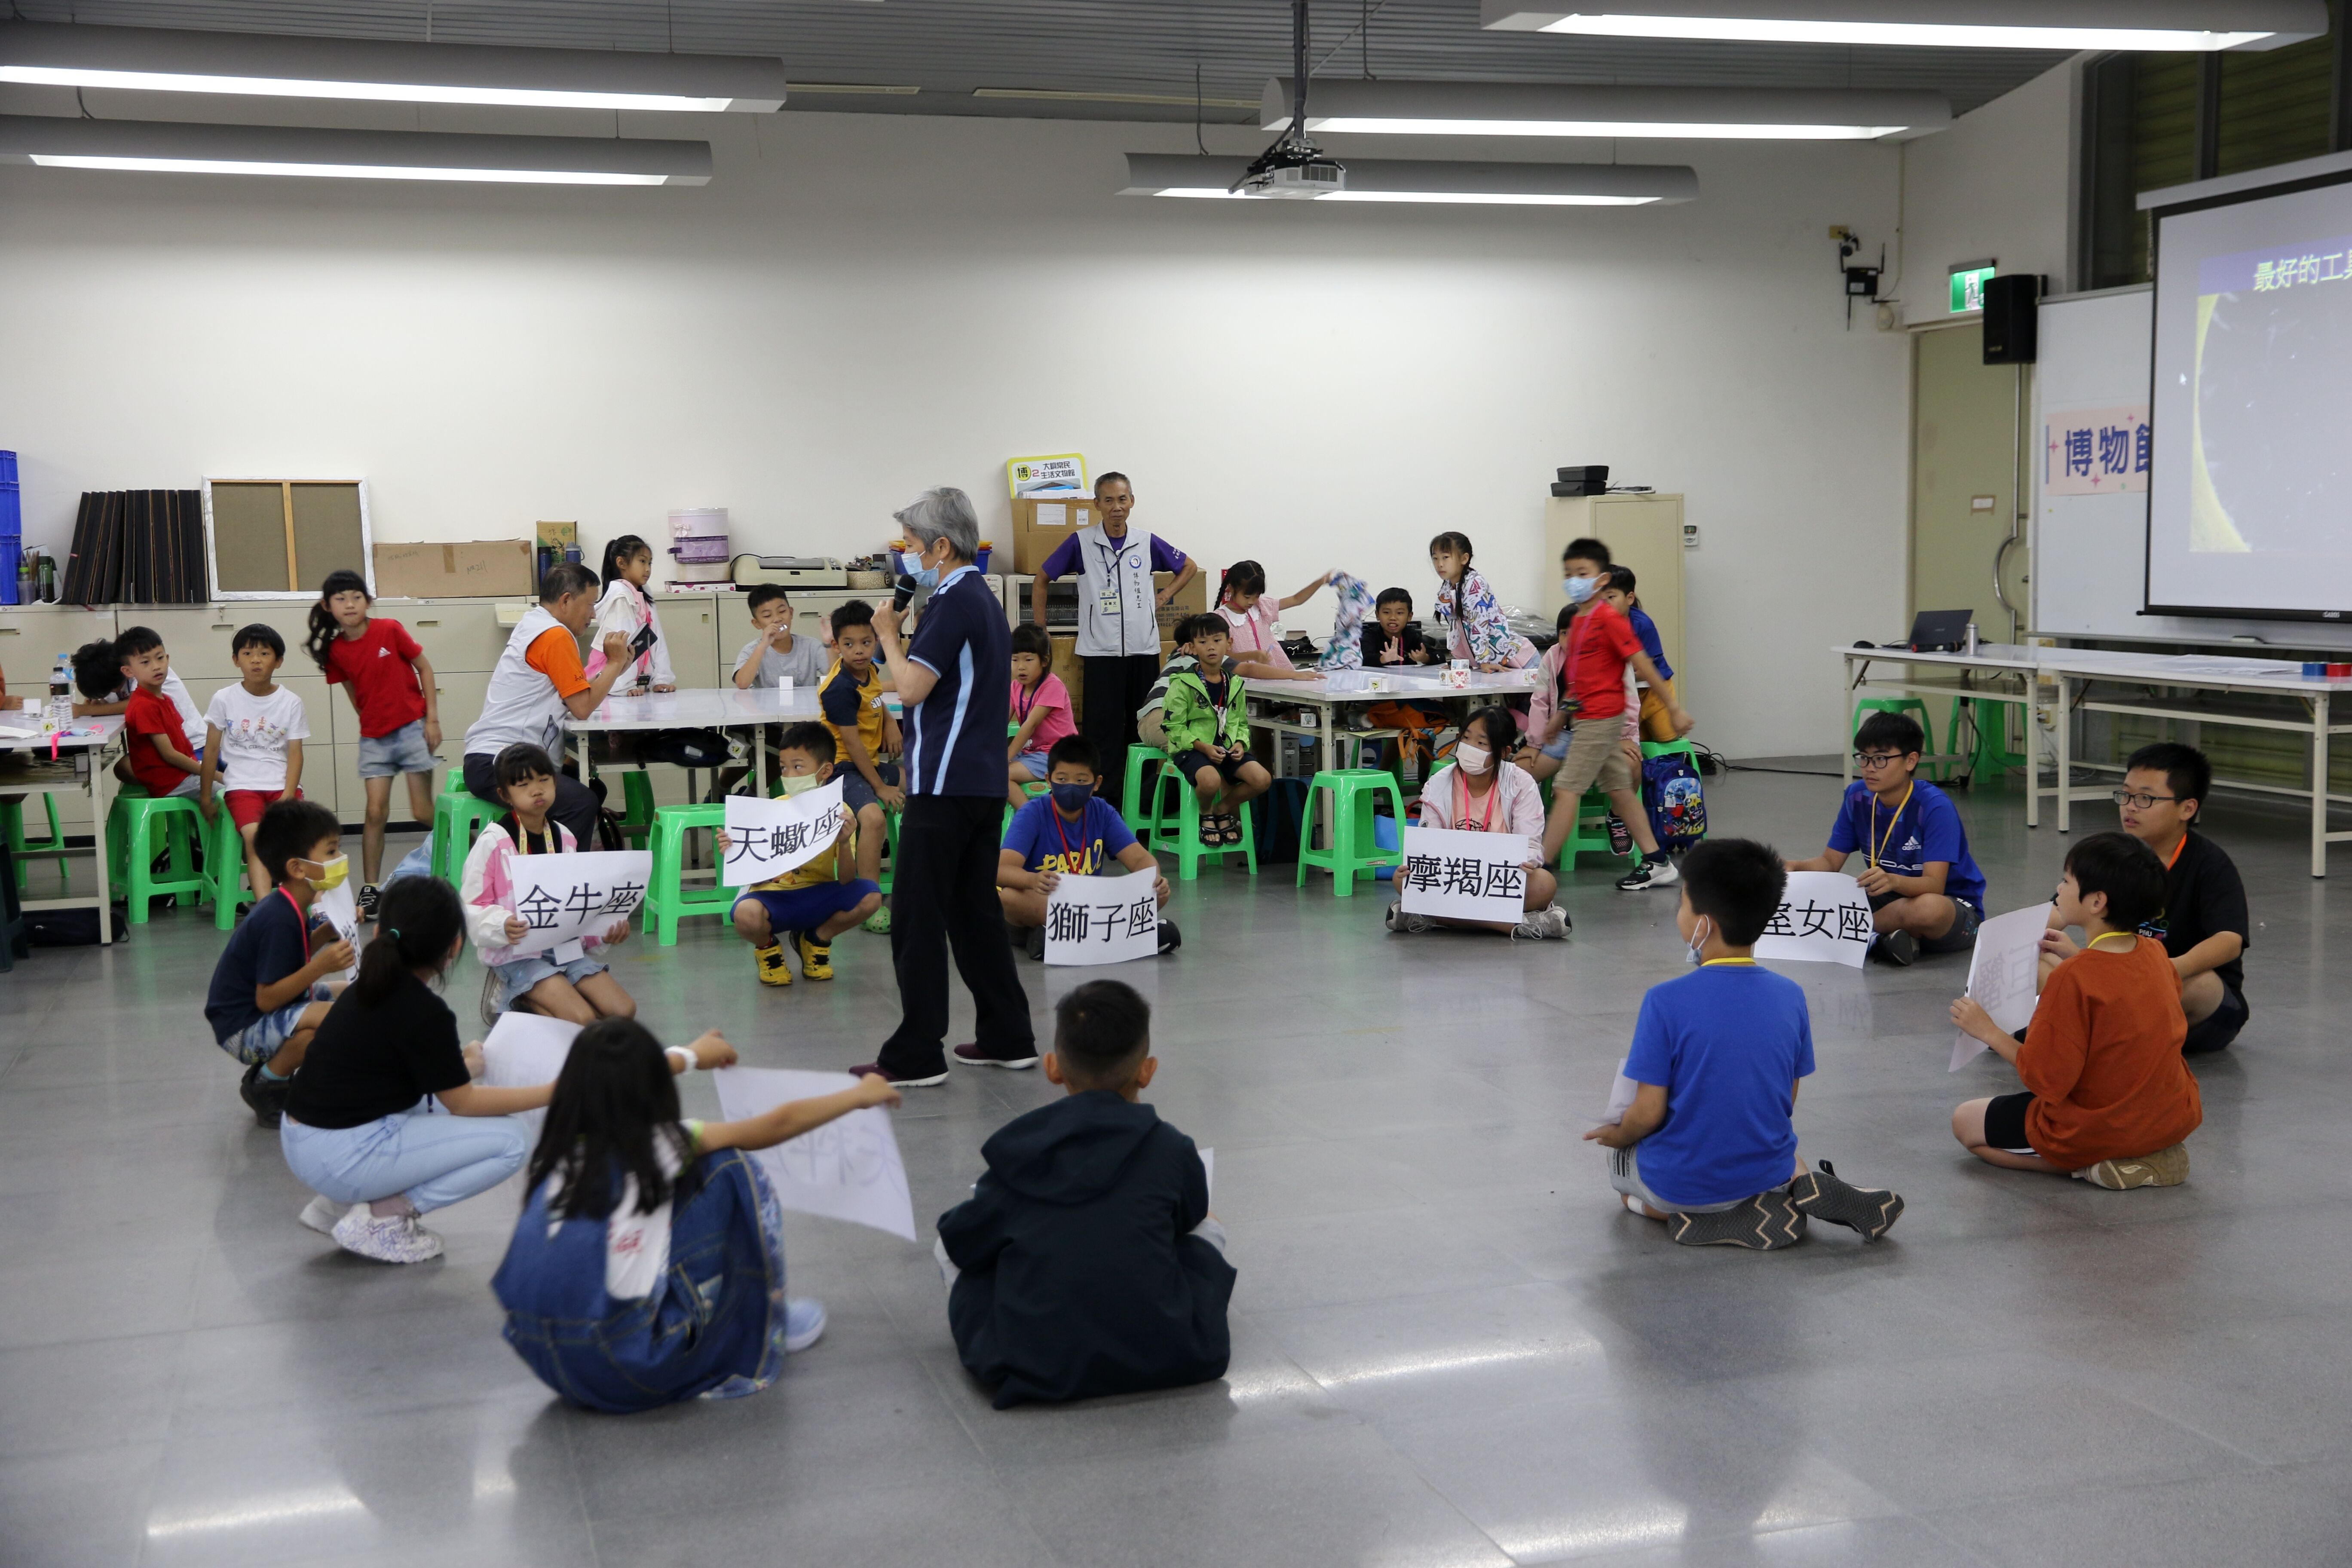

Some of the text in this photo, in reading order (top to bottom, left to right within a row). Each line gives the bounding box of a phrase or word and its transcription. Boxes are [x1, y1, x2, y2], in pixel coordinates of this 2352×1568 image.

[1017, 467, 1028, 478] 博
[1041, 469, 1075, 479] 生活文物館
[726, 802, 844, 864] 天蠍座
[1404, 854, 1523, 899] 摩羯座
[517, 881, 645, 930] 金牛座
[1047, 896, 1156, 943] 獅子座
